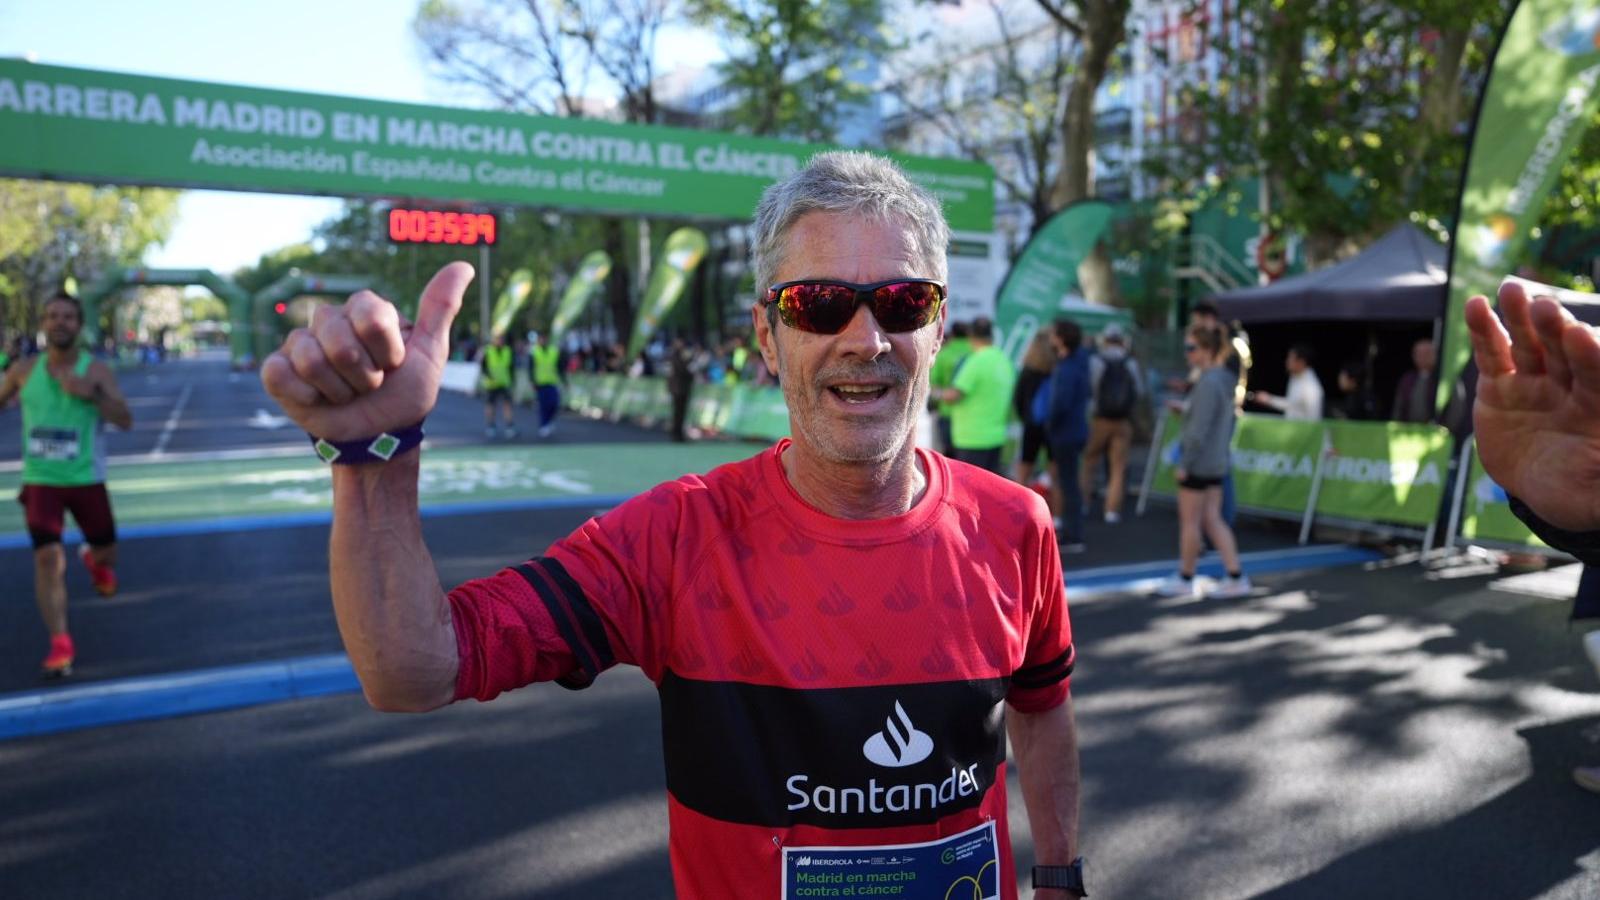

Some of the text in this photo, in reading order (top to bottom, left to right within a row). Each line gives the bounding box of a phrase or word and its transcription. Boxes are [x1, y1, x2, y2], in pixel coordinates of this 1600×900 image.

[0, 77, 167, 126] ARRERA
[175, 96, 324, 140] MADRID
[332, 112, 379, 144] EN
[387, 117, 528, 156] MARCHA
[531, 132, 654, 167] CONTRA
[658, 143, 691, 170] EL
[191, 138, 665, 198] Asociación Española Contra el Cáncer
[786, 763, 980, 814] Santander
[796, 870, 916, 884] Madrid en marcha
[812, 858, 854, 866] IBERDROLA
[795, 884, 904, 897] contra el cáncer
